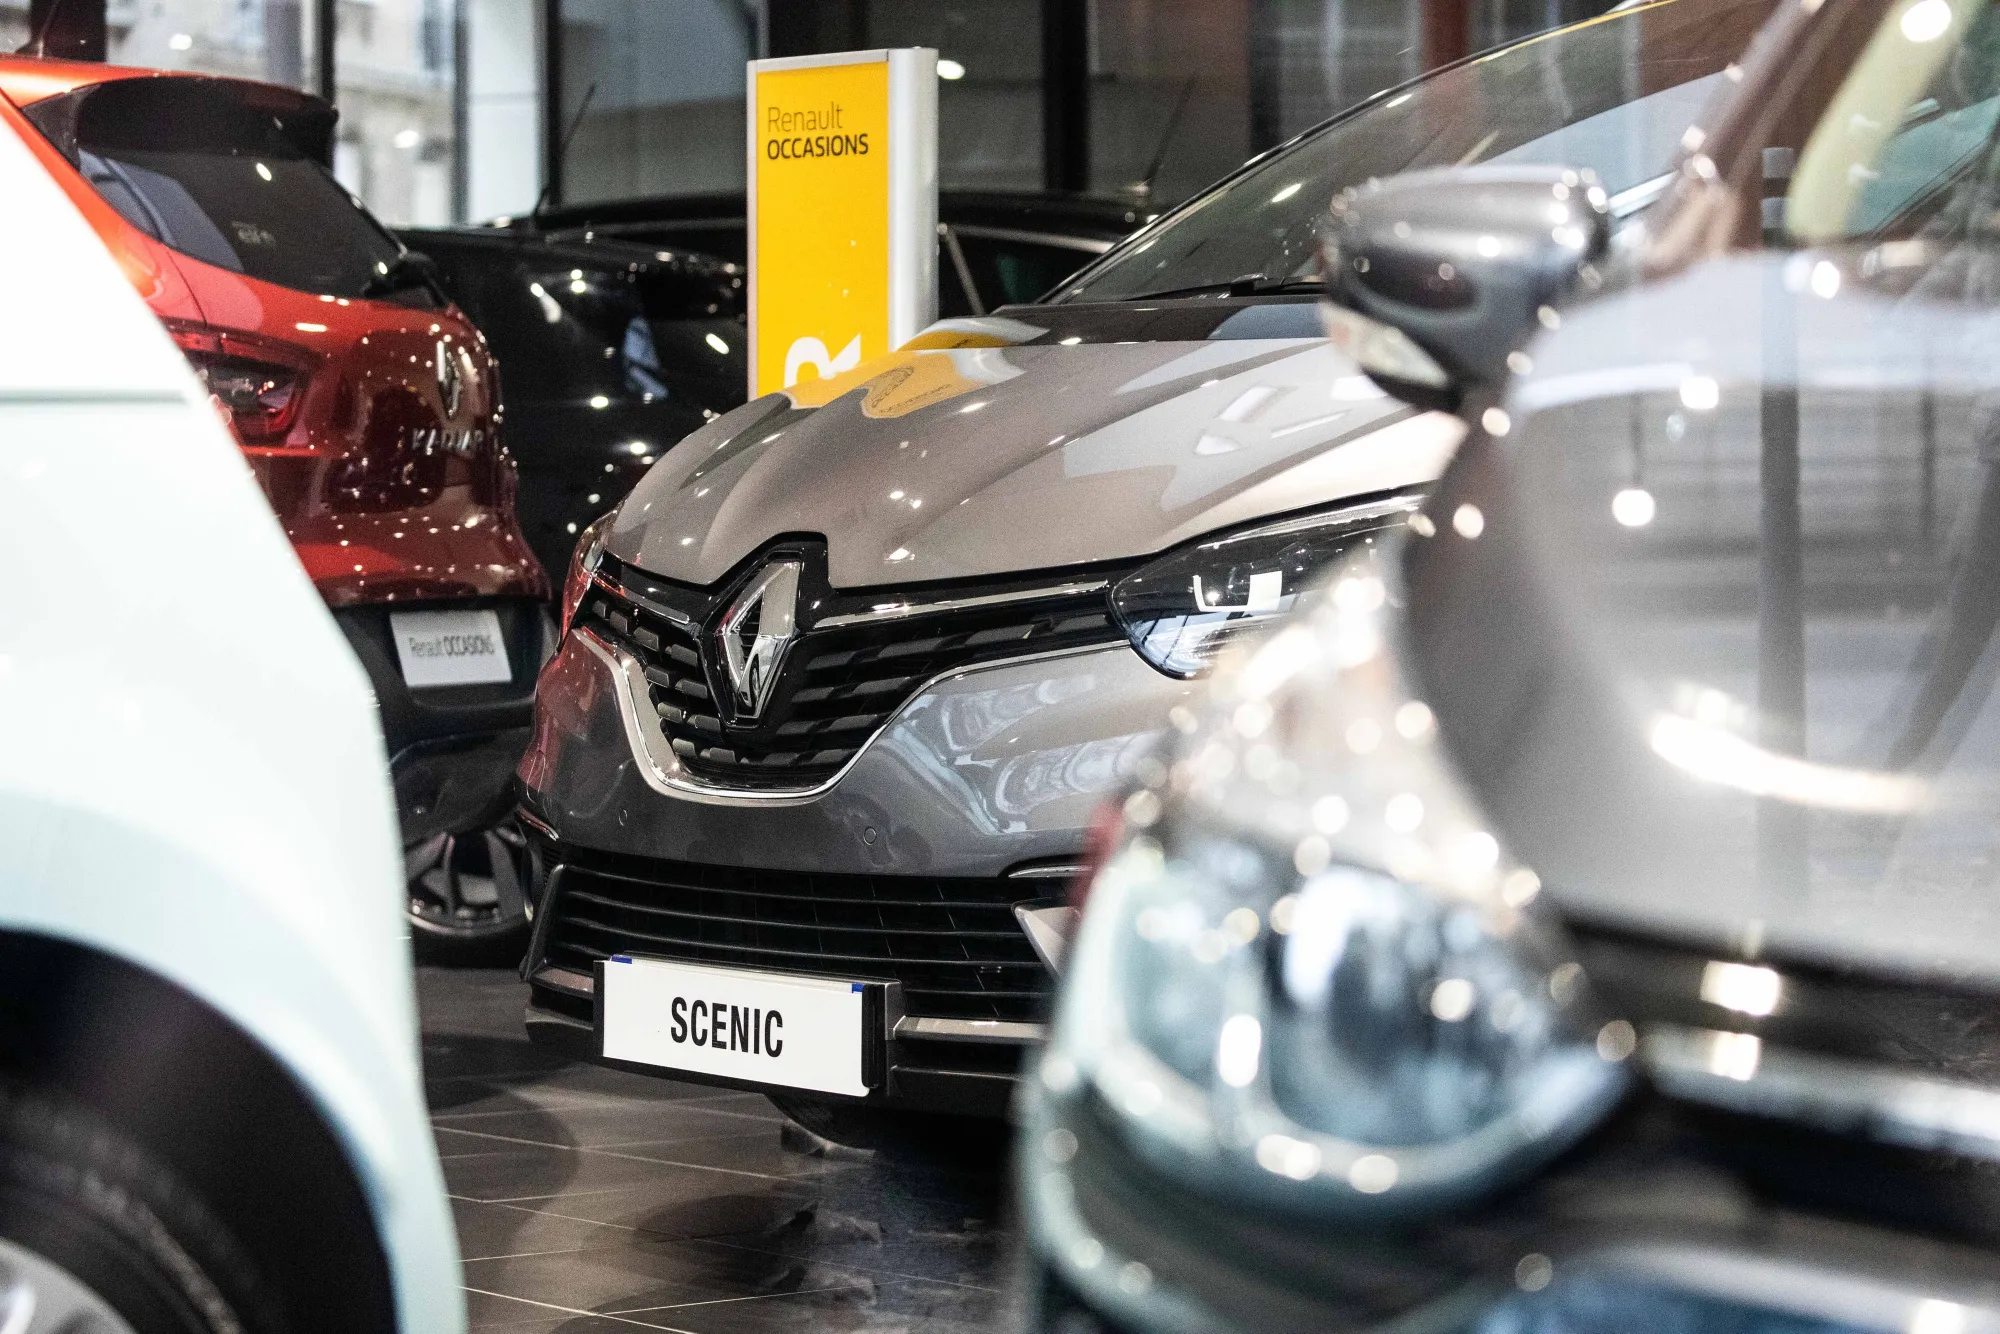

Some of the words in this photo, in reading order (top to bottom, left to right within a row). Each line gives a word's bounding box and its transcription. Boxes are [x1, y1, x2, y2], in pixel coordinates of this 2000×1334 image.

[767, 101, 843, 133] Renault
[767, 133, 869, 160] OCCASIONS
[670, 996, 784, 1058] SCENIC
